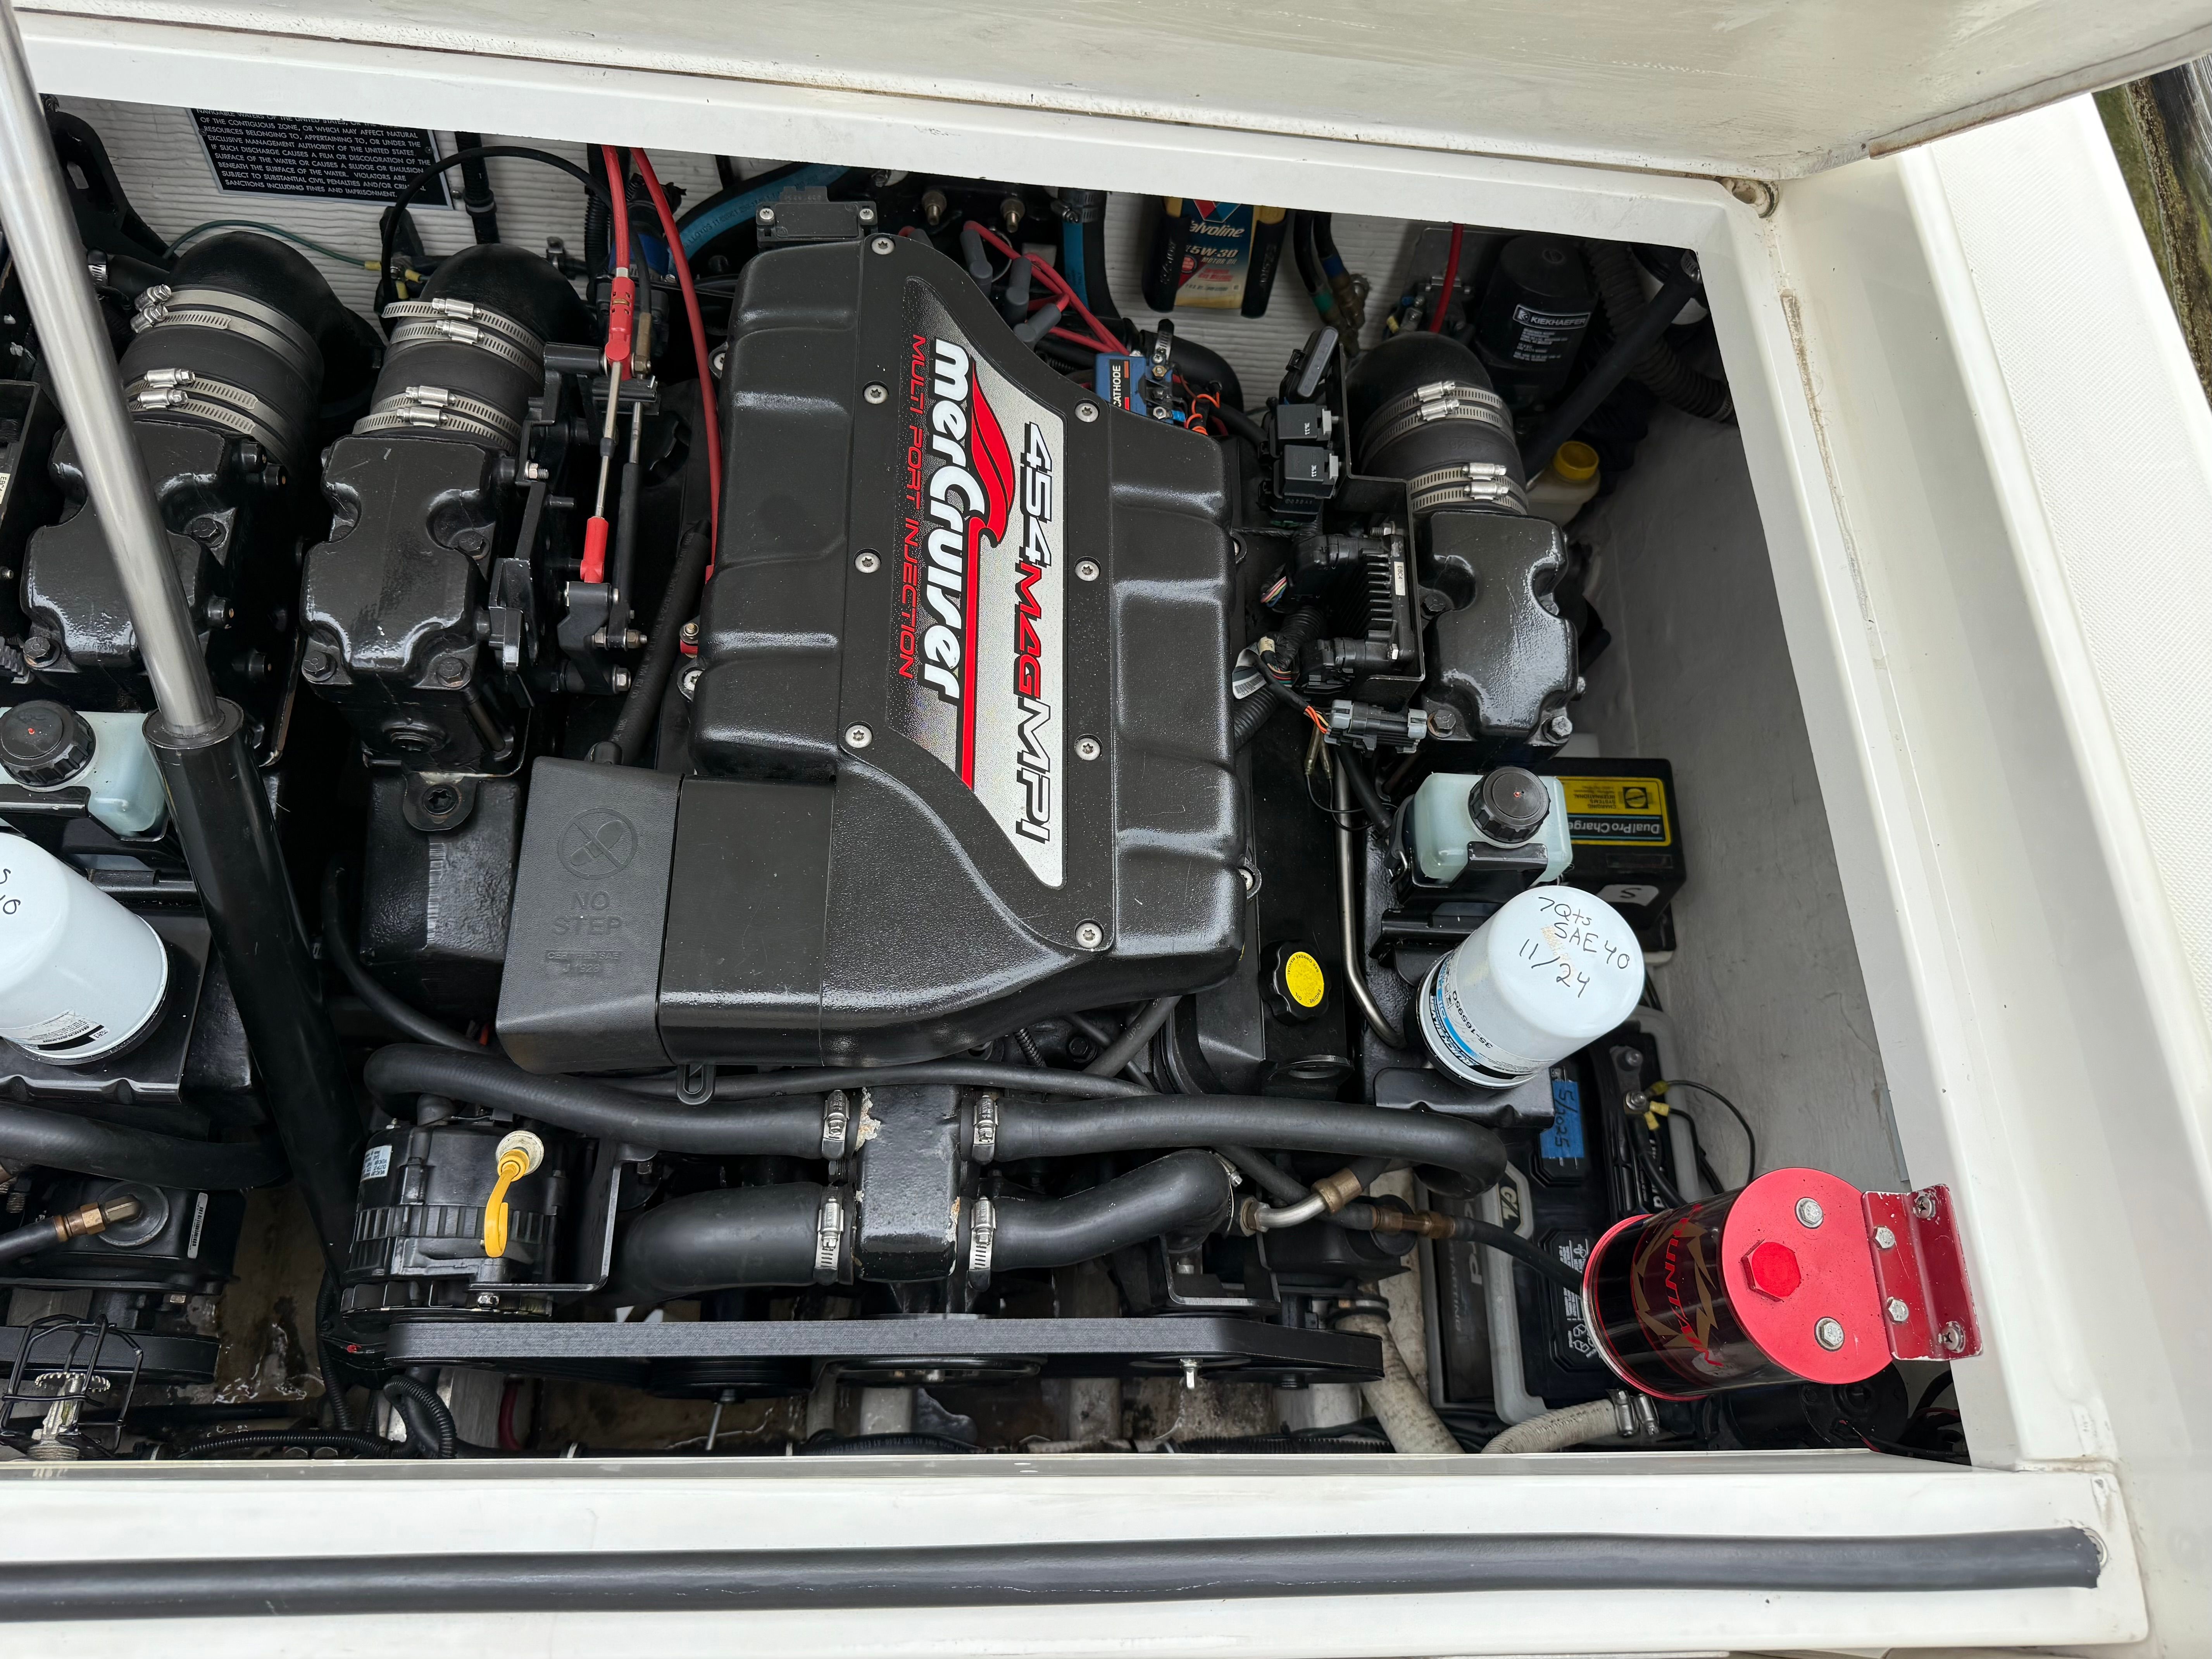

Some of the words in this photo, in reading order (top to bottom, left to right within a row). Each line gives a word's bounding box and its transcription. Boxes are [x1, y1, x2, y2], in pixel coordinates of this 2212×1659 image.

[228, 120, 275, 129] CONTIGUOUS
[204, 126, 243, 135] RESOURCES
[305, 135, 352, 143] APPERTAINING
[207, 135, 243, 144] EXCLUSIVE
[245, 139, 295, 147] MANAGEMENT
[241, 147, 280, 155] DISCHARGE
[349, 155, 404, 164] DISCOLORATION
[264, 174, 307, 183] SUBSTANTIAL
[225, 179, 265, 188] SANCTIONS
[346, 188, 397, 197] IMPRISONMENT.
[1531, 317, 1586, 326] KIEKHAEFER
[910, 335, 926, 414] MULTI
[1112, 364, 1121, 407] CATHODE
[907, 425, 923, 509] PORT
[900, 518, 919, 679] INJECTION
[1612, 823, 1631, 833] Pro
[570, 890, 611, 910] NO
[553, 915, 622, 935] STEP
[1309, 988, 1321, 1004] ENGINE
[1452, 990, 1493, 1049] 35-16595Q
